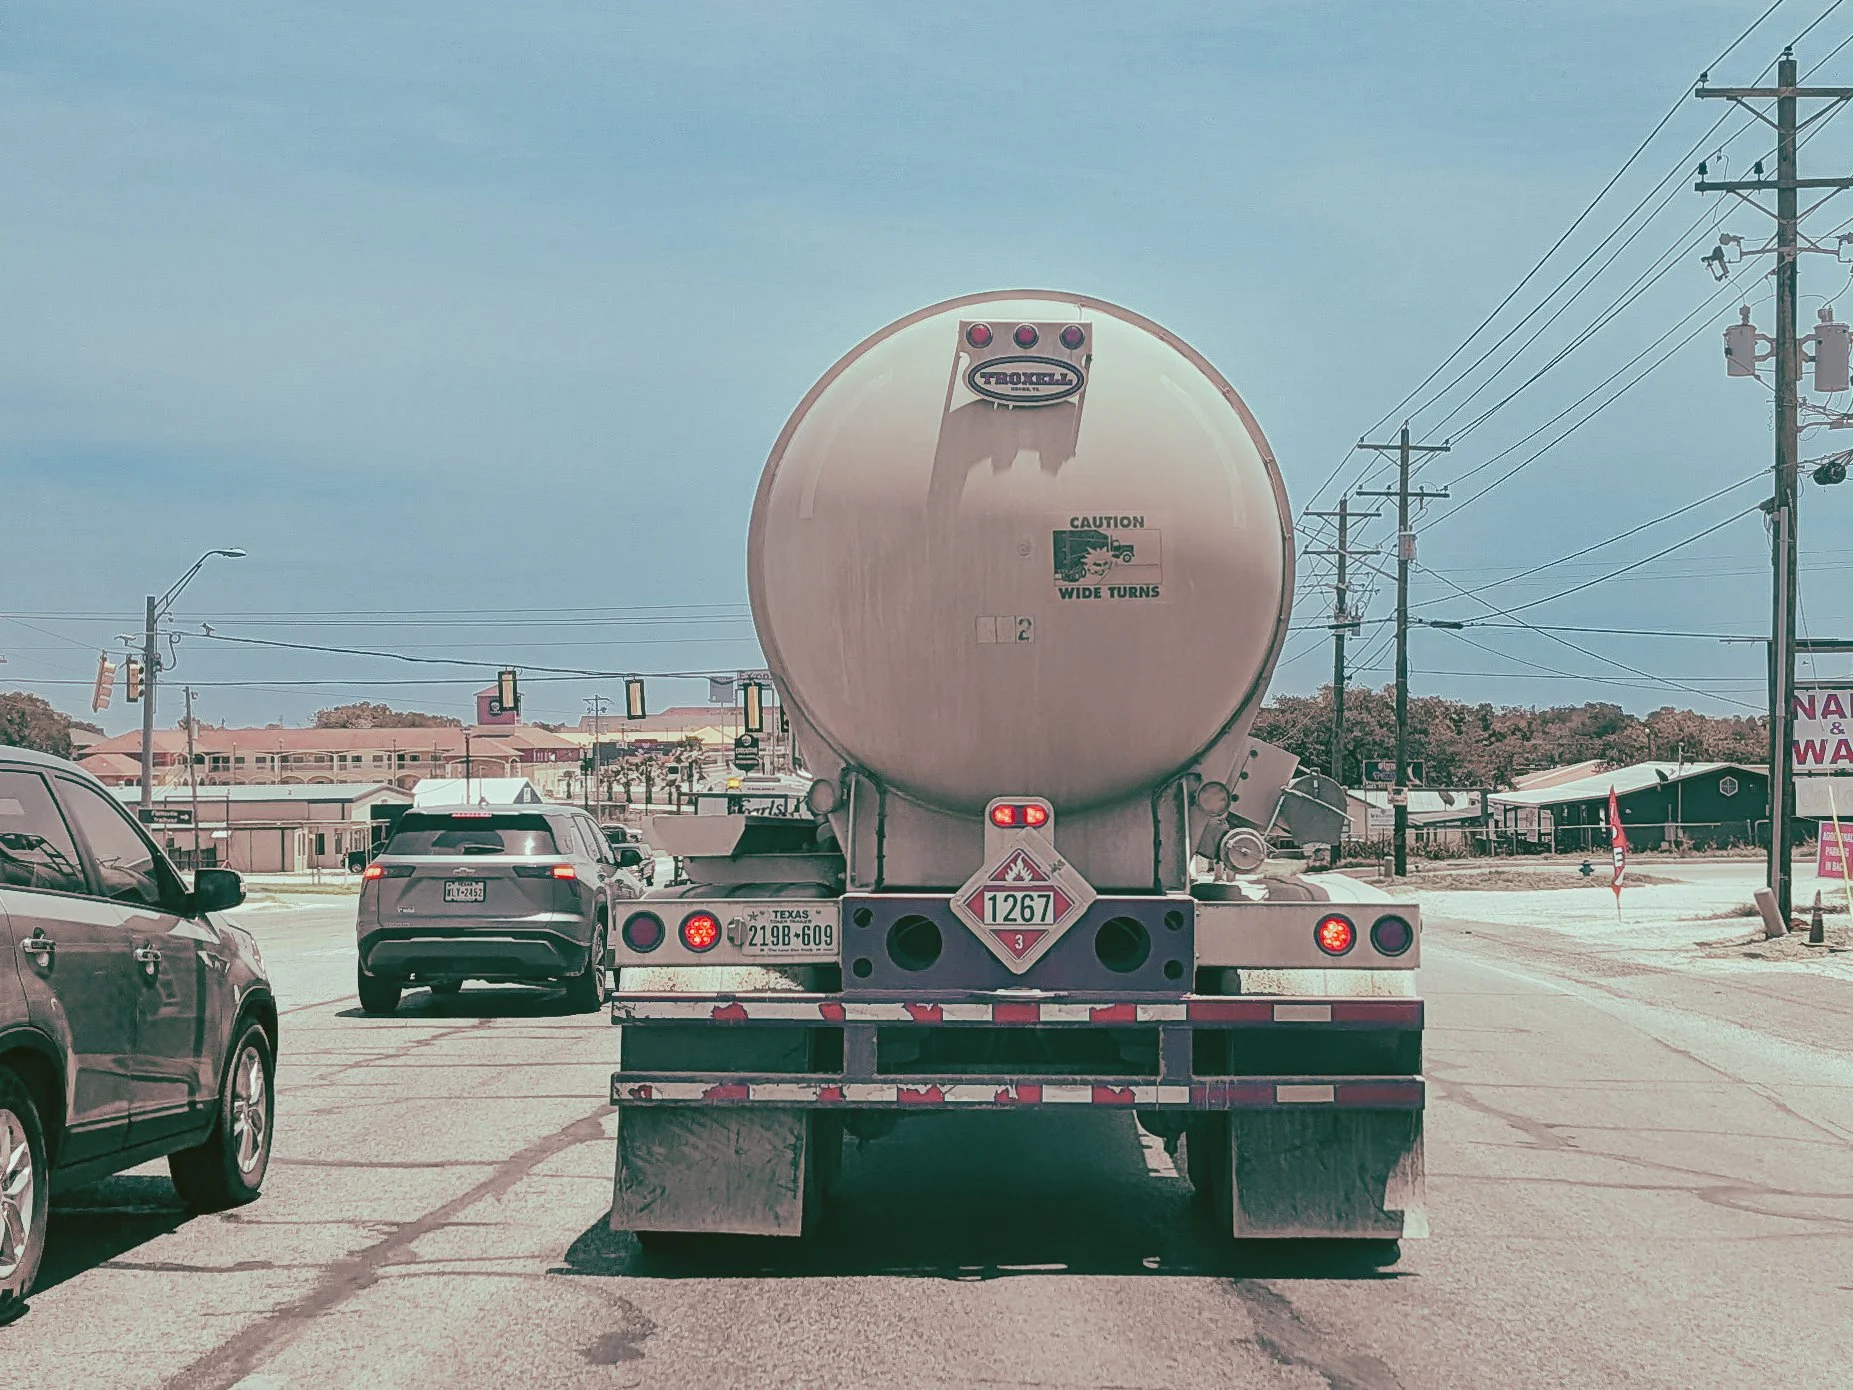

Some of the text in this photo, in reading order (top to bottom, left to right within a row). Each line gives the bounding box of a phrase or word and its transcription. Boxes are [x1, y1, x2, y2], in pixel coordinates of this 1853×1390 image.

[979, 371, 1073, 386] TROXELL
[1069, 516, 1145, 529] CAUTION
[1058, 585, 1160, 600] WIDE TURNS
[1018, 618, 1032, 641] 2
[1792, 693, 1853, 721] NA
[1830, 721, 1846, 735] &
[772, 910, 809, 919] TEXAS
[987, 893, 1051, 923] 1267
[748, 924, 833, 947] 219B 609
[1015, 934, 1023, 949] 3
